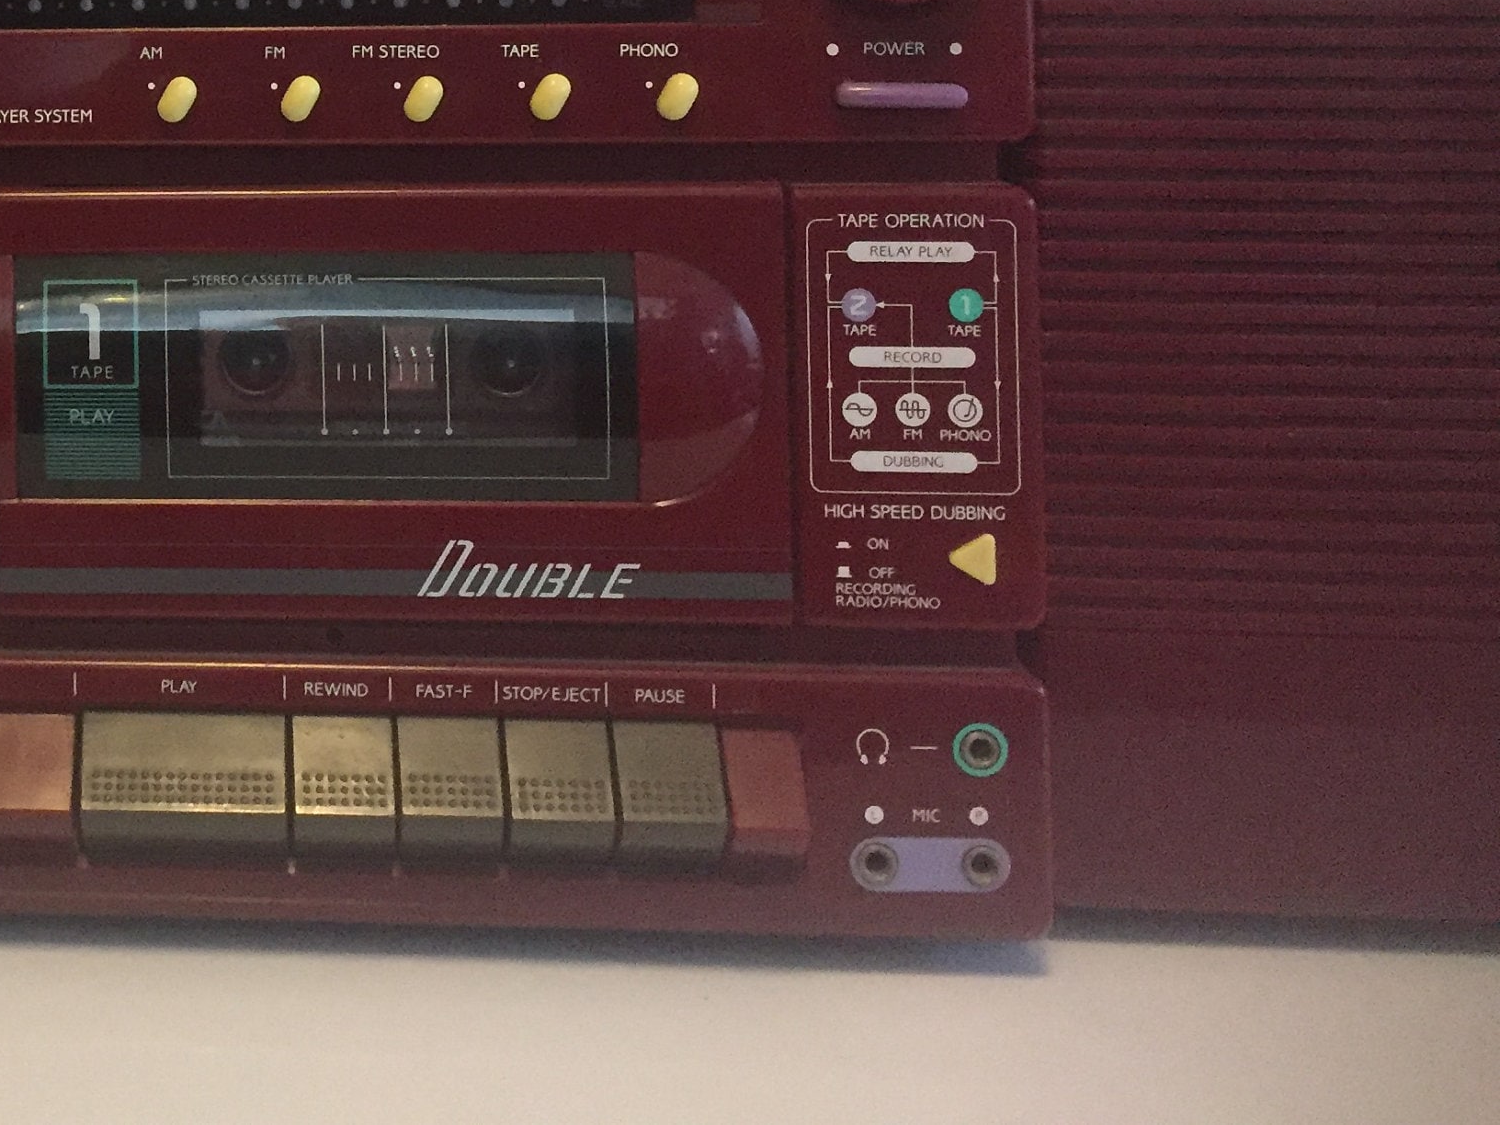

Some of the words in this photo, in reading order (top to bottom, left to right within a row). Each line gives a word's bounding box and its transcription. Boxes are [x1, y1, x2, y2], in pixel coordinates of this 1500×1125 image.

[139, 46, 163, 60] AM
[264, 45, 285, 60] FM
[352, 44, 373, 59] FM
[379, 44, 440, 59] STEREO
[501, 43, 539, 58] TAPE
[620, 42, 679, 57] PHONO
[863, 41, 925, 56] POWER
[34, 108, 93, 124] SYSTEM
[837, 213, 878, 228] TAPE
[885, 213, 984, 228] OPERATION
[870, 245, 913, 257] RELAY
[918, 245, 952, 257] PLAY
[192, 274, 239, 286] STEREO
[244, 274, 304, 286] CASSETTE
[308, 273, 353, 285] PLAYER
[850, 295, 867, 316] 2
[962, 295, 970, 316] 1
[79, 302, 100, 360] 1
[843, 325, 877, 337] TAPE
[948, 325, 981, 337] TAPE
[884, 351, 942, 364] RECORD
[71, 365, 114, 380] TAPE
[69, 408, 115, 425] PLAY
[849, 428, 871, 440] AM
[903, 428, 923, 440] FM
[940, 429, 992, 442] PHONO
[883, 455, 944, 468] DUBBING
[824, 503, 865, 519] HIGH
[870, 504, 924, 520] SPEED
[930, 505, 1006, 521] DUBBING
[867, 538, 889, 550] ON
[869, 566, 895, 579] OFF
[836, 582, 916, 596] RECORDING
[836, 595, 941, 610] RADIO/PHONO
[161, 679, 197, 694] PLAY
[304, 681, 368, 698] REWIND
[415, 683, 473, 699] FAST-F
[502, 686, 601, 703] STOP/EJECT
[635, 688, 685, 704] PAUSE
[912, 808, 941, 823] MIC
